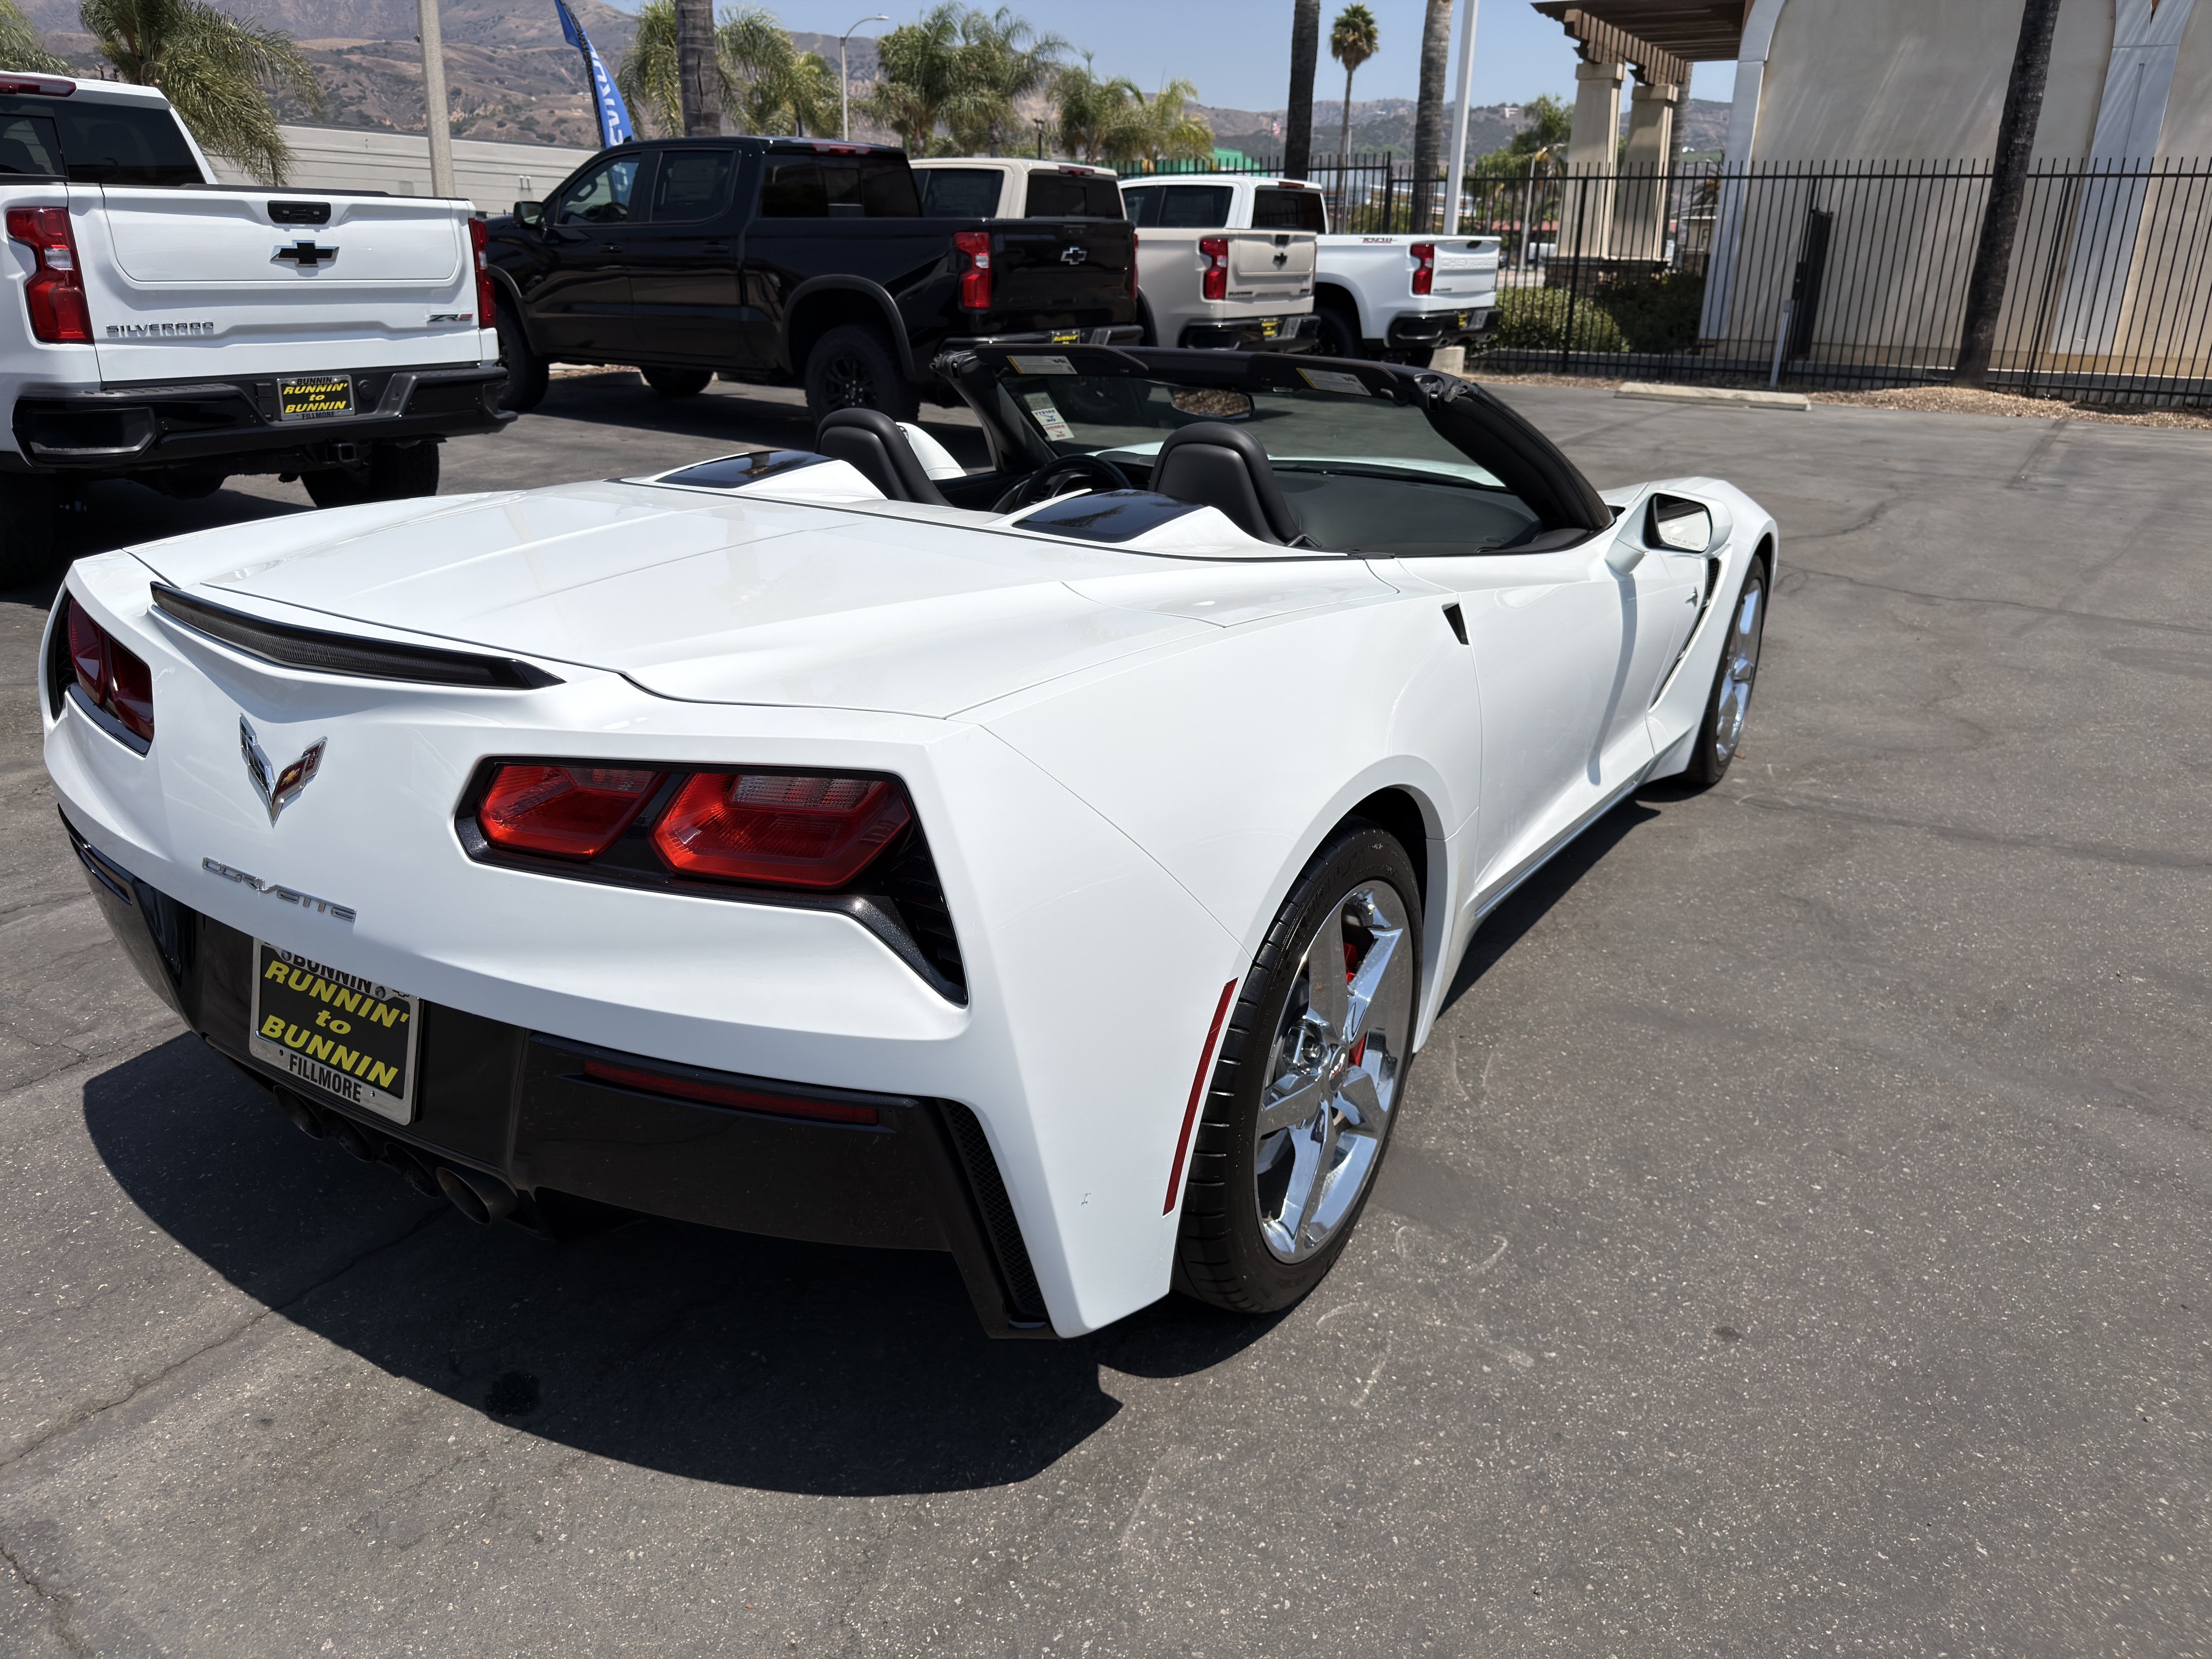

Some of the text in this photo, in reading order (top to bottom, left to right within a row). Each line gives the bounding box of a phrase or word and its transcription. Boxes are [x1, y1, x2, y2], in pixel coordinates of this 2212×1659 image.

[106, 321, 213, 332] SILVERADO
[283, 383, 348, 394] RUNNIN'
[297, 376, 332, 385] BUNNIN
[285, 400, 347, 413] BUNNIN
[202, 856, 357, 922] CORVETTE
[292, 954, 372, 994] BUNNIN
[264, 960, 410, 1028] RUNNIN'
[315, 1009, 351, 1035] to
[261, 1014, 399, 1088] BUNNIN
[289, 1053, 362, 1103] FILLMORE
